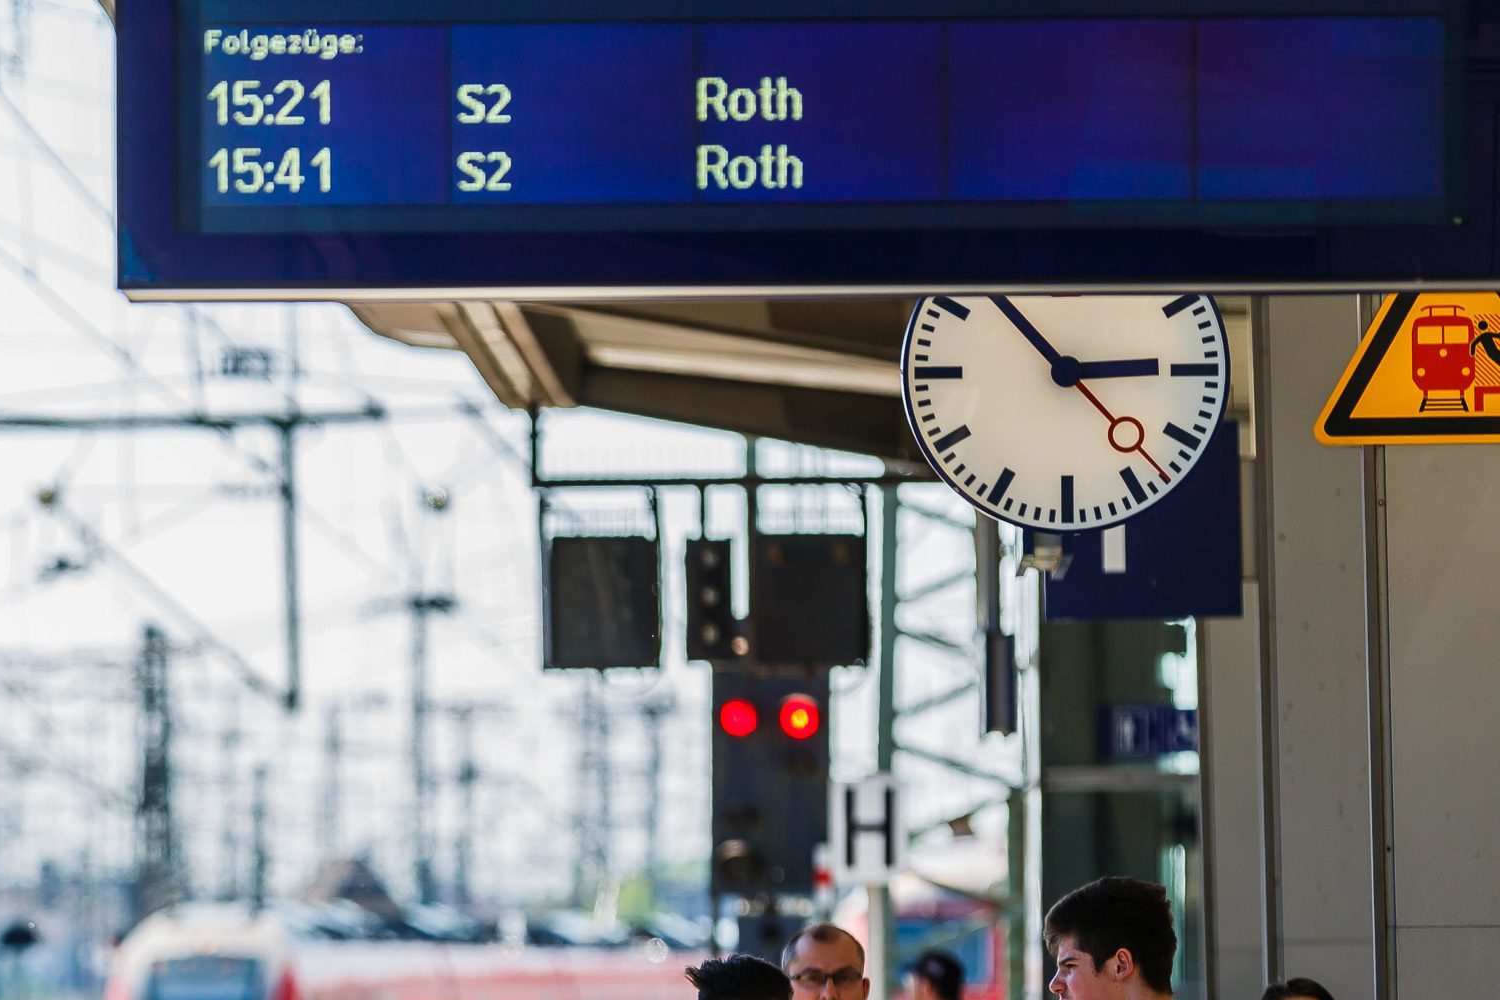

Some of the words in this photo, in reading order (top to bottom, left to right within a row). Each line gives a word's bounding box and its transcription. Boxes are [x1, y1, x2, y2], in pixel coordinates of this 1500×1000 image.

[203, 28, 364, 61] Folgezüge:
[207, 79, 331, 126] 15:21
[456, 83, 512, 124] S2
[696, 76, 803, 122] Roth
[207, 147, 331, 194] 15:41
[456, 151, 512, 192] S2
[696, 144, 803, 190] Roth
[845, 786, 894, 866] H
